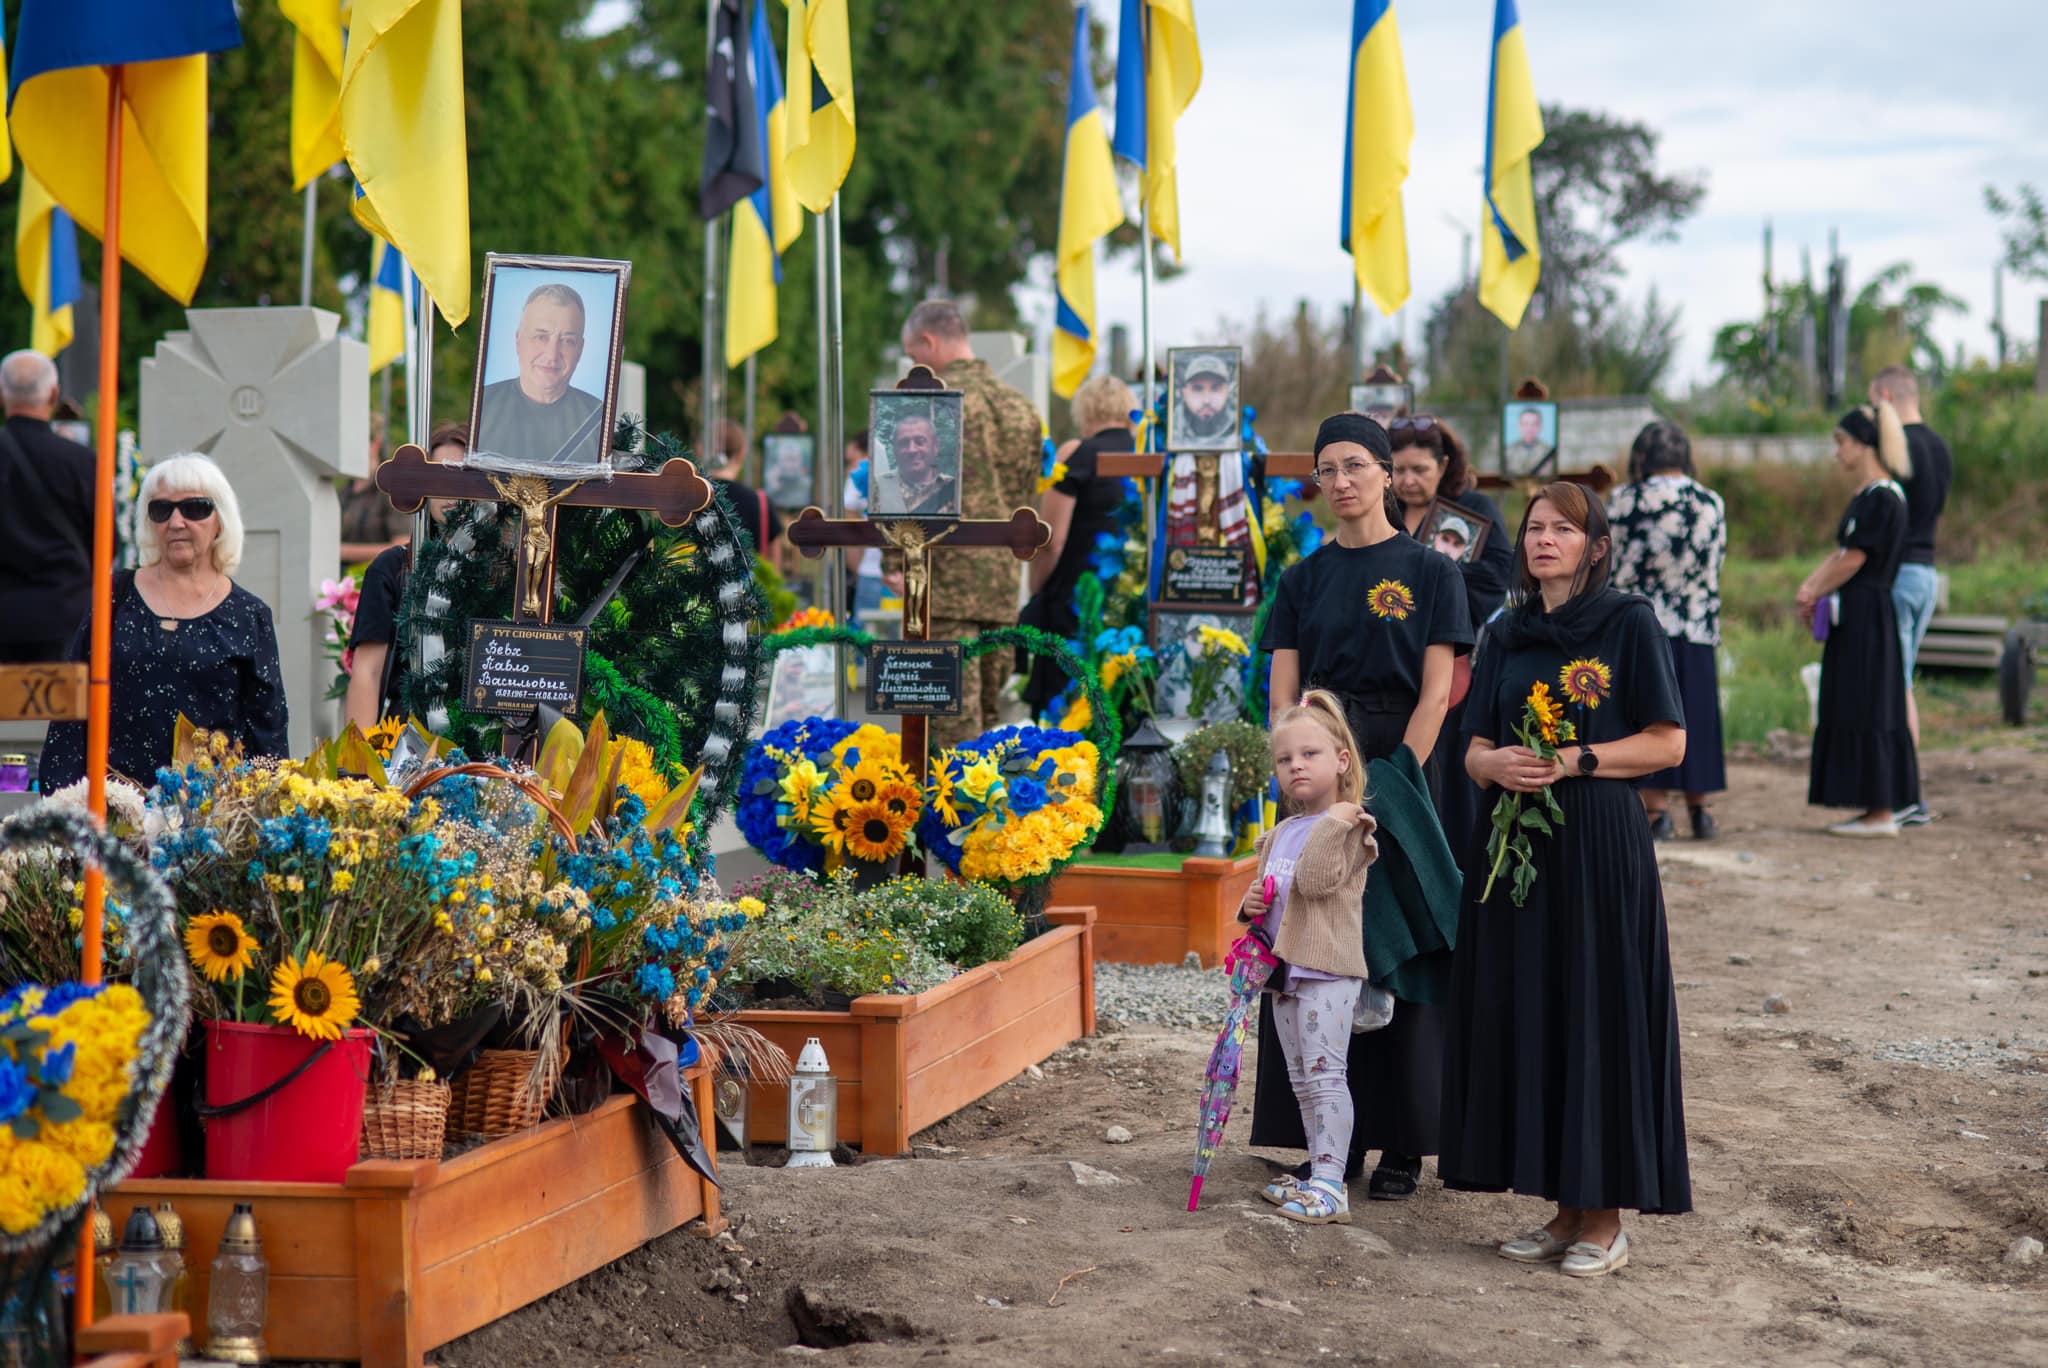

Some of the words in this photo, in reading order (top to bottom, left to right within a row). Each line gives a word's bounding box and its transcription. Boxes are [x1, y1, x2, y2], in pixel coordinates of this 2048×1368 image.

[493, 629, 511, 638] ТУТ
[512, 630, 565, 641] СПОЧИВАЄ
[485, 639, 522, 657] Бевх
[482, 655, 529, 673] Павло
[479, 671, 567, 689] Васильович
